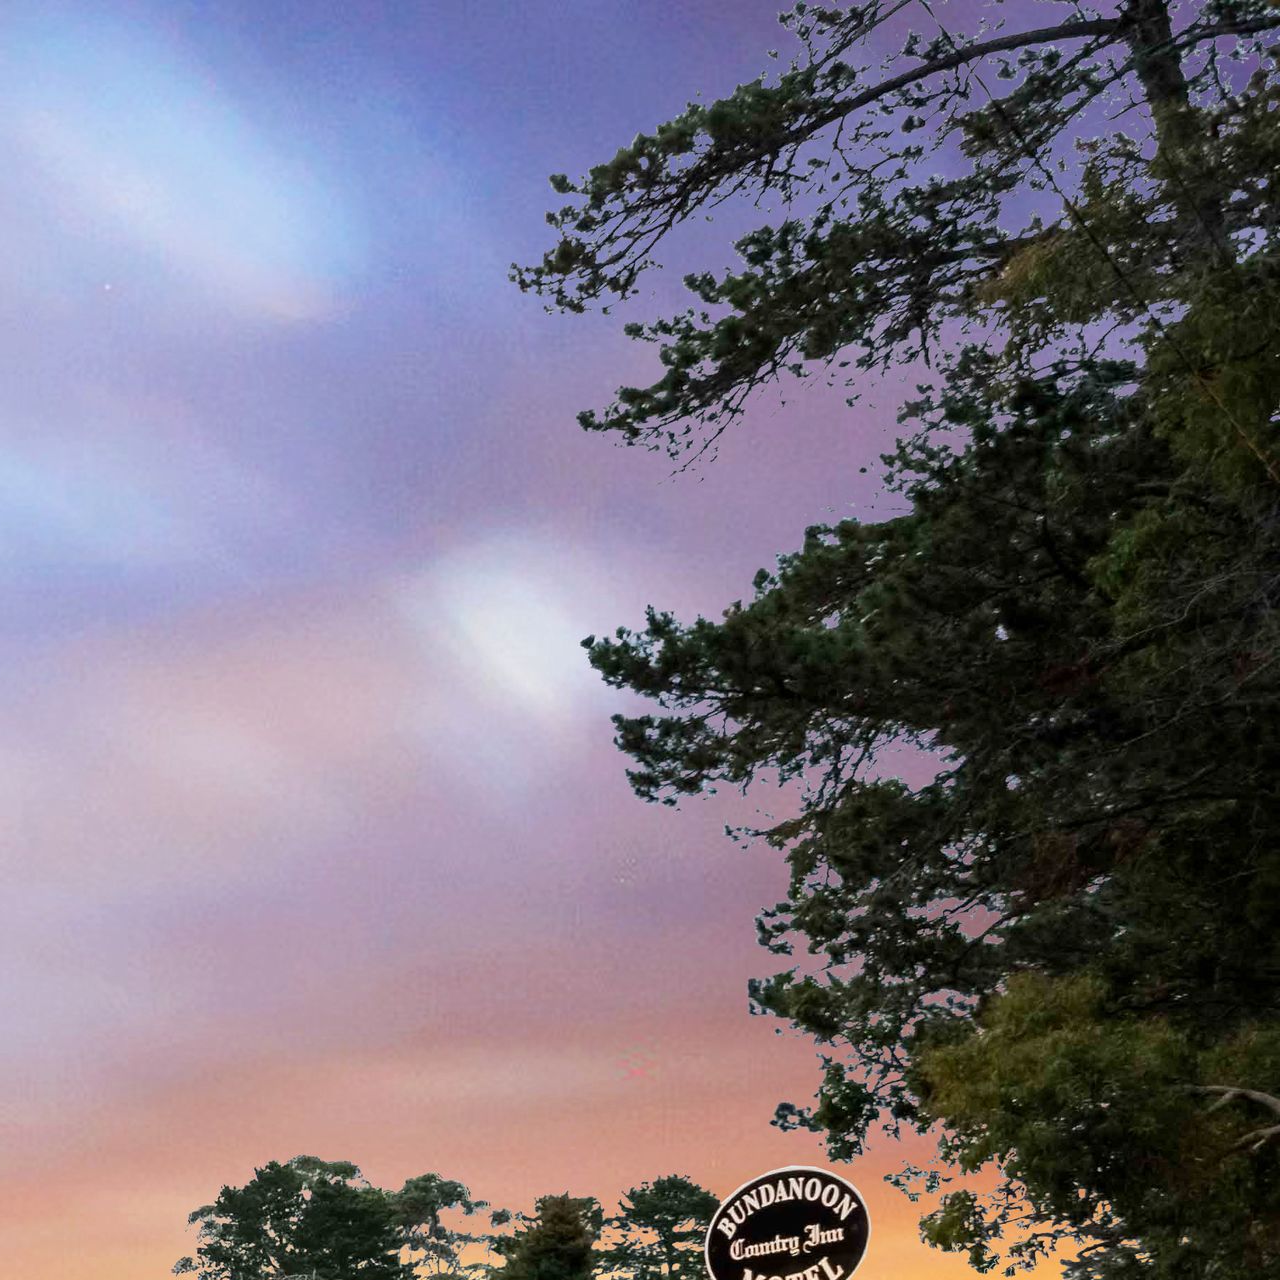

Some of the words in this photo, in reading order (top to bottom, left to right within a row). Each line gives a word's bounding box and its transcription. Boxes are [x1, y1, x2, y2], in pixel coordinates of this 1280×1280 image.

[717, 1177, 858, 1240] BUNDANOON
[730, 1234, 799, 1260] Country
[803, 1223, 845, 1253] Inn
